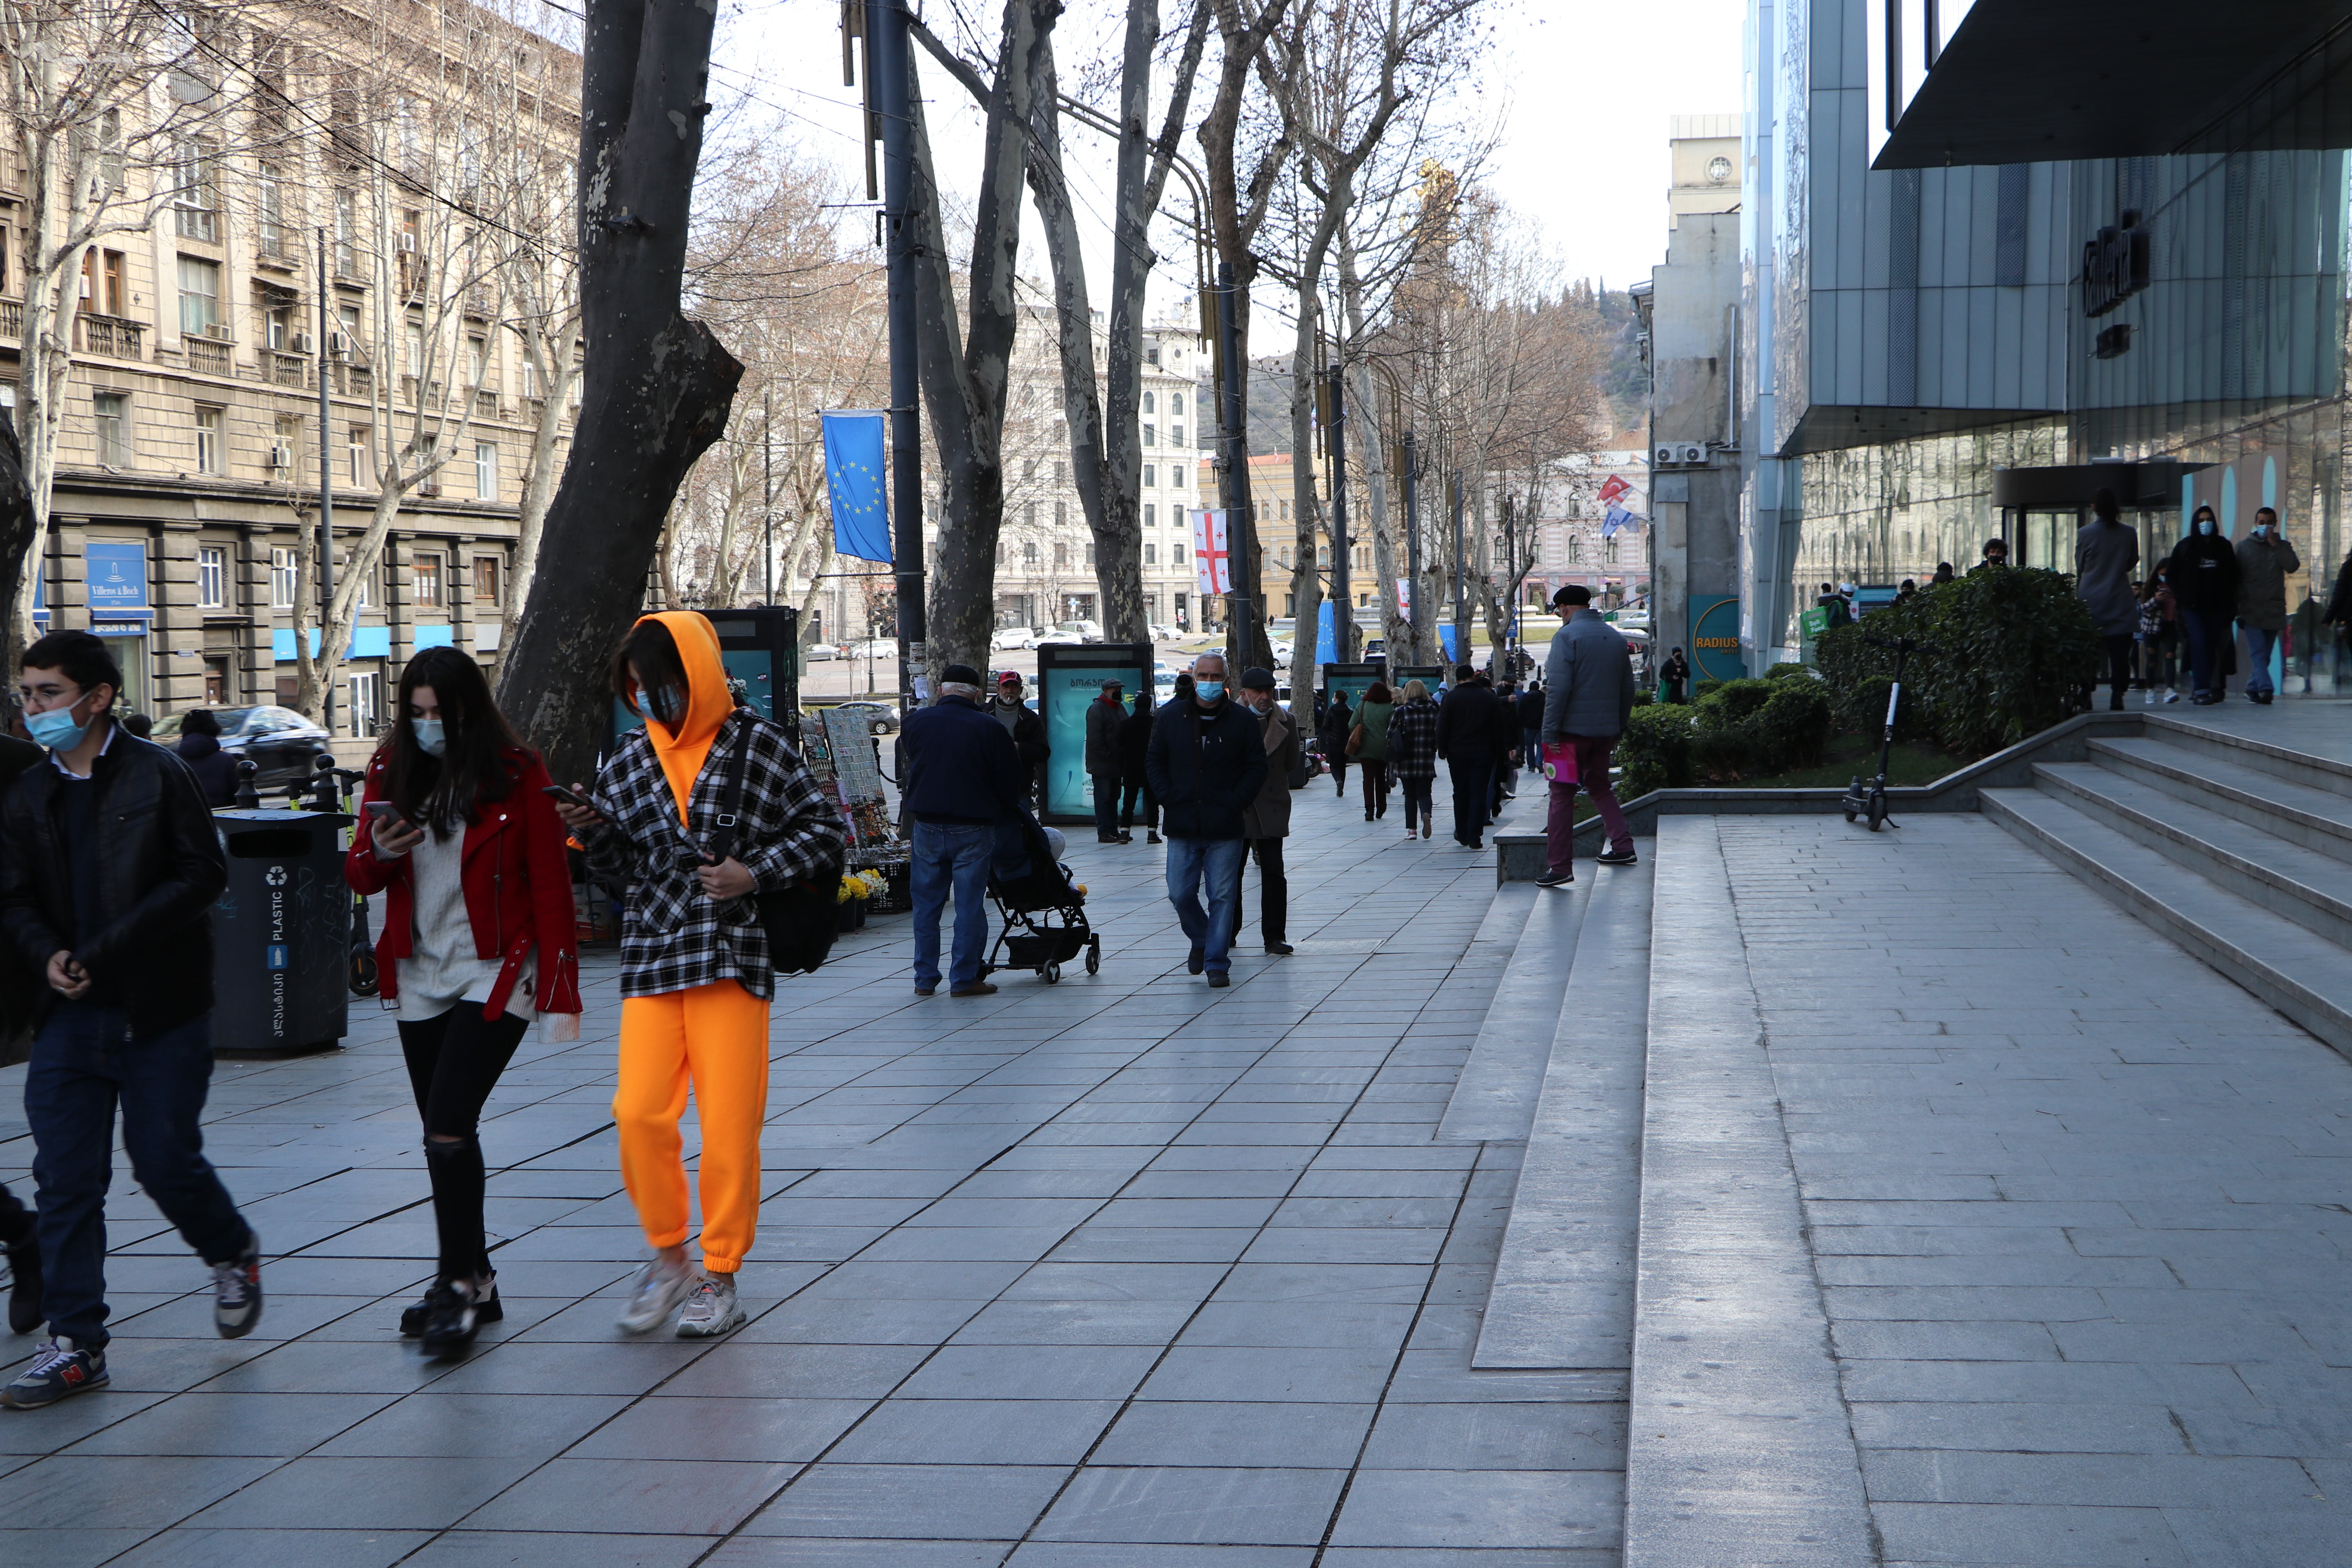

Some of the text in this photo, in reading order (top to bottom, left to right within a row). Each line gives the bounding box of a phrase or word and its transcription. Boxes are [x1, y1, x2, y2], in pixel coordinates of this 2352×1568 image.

[123, 585, 139, 595] Boch
[1811, 624, 1825, 633] Food
[1697, 637, 1738, 648] RADIUS
[272, 891, 283, 941] PLASTIC
[273, 973, 283, 1037] პლასტიკი
